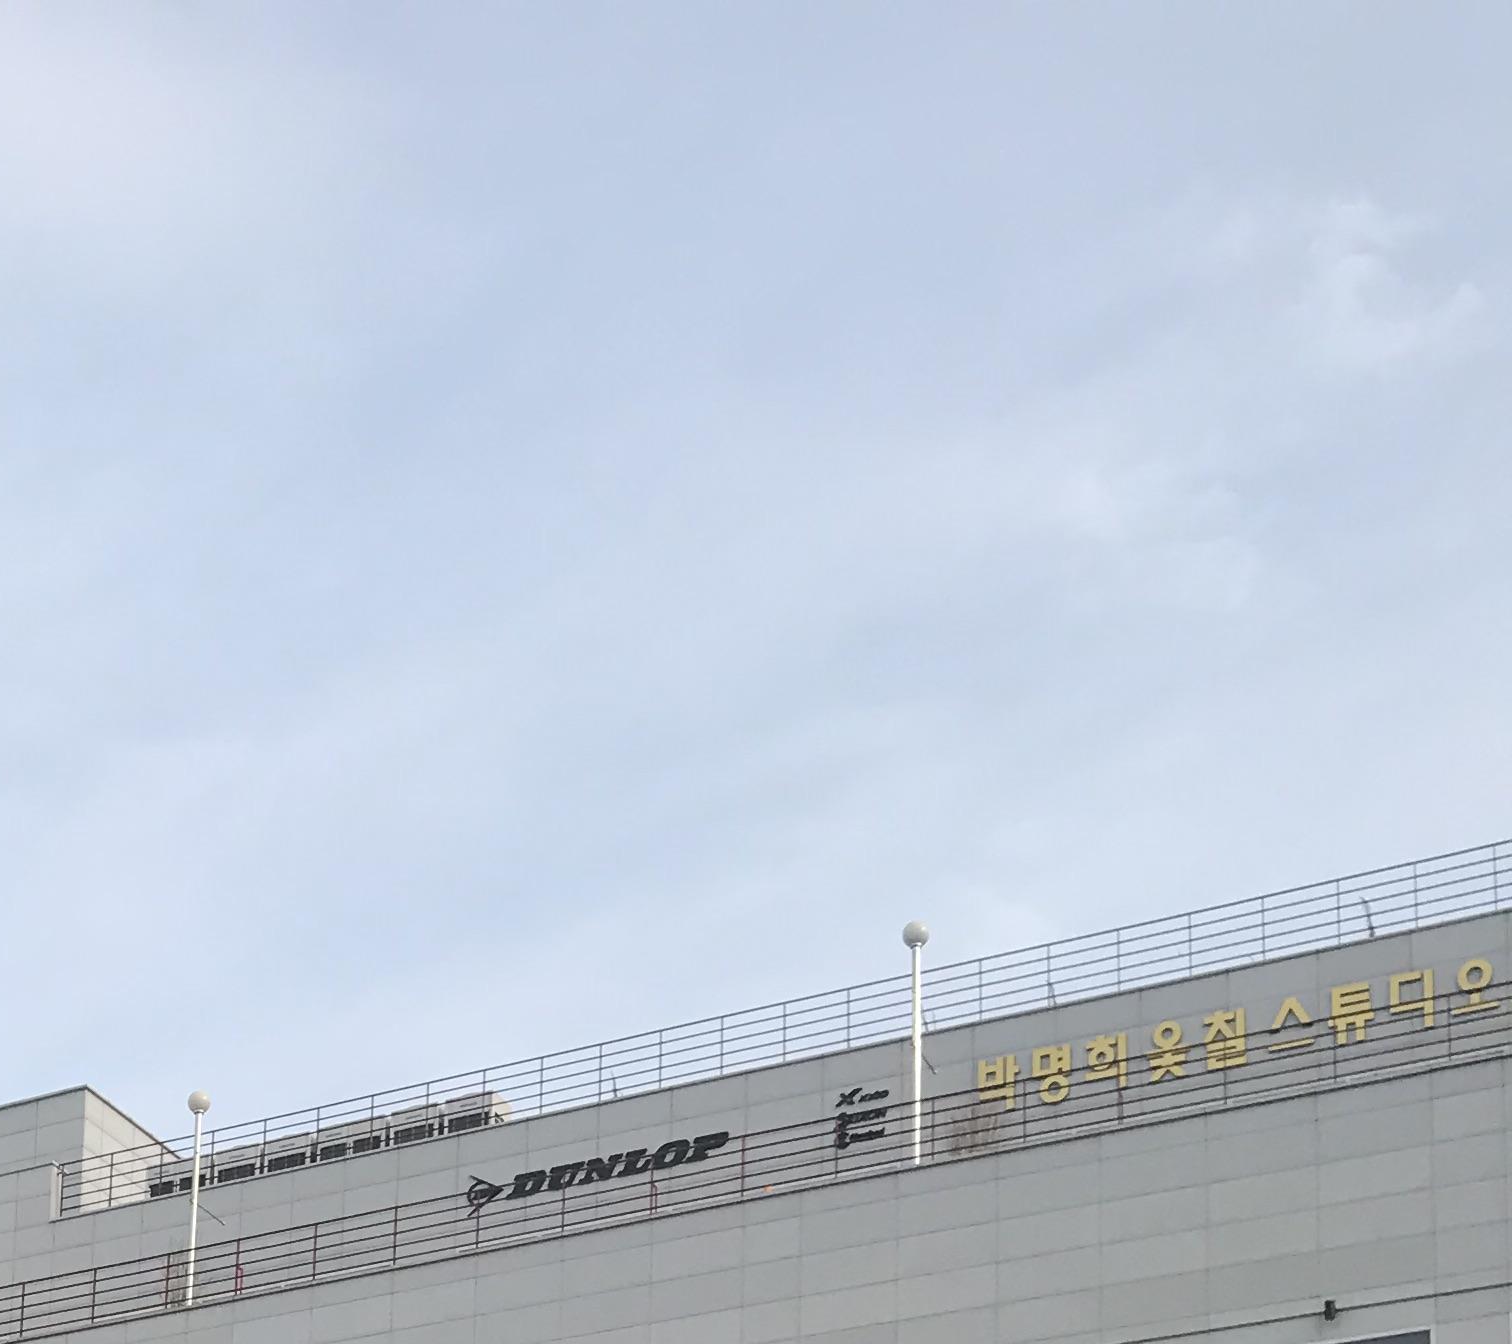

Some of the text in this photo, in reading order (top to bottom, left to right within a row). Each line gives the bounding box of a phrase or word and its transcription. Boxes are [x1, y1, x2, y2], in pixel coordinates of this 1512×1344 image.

[977, 1031, 1128, 1110] 박명희
[1267, 958, 1500, 1052] 스튜디오
[506, 1132, 729, 1200] DUNLOP
